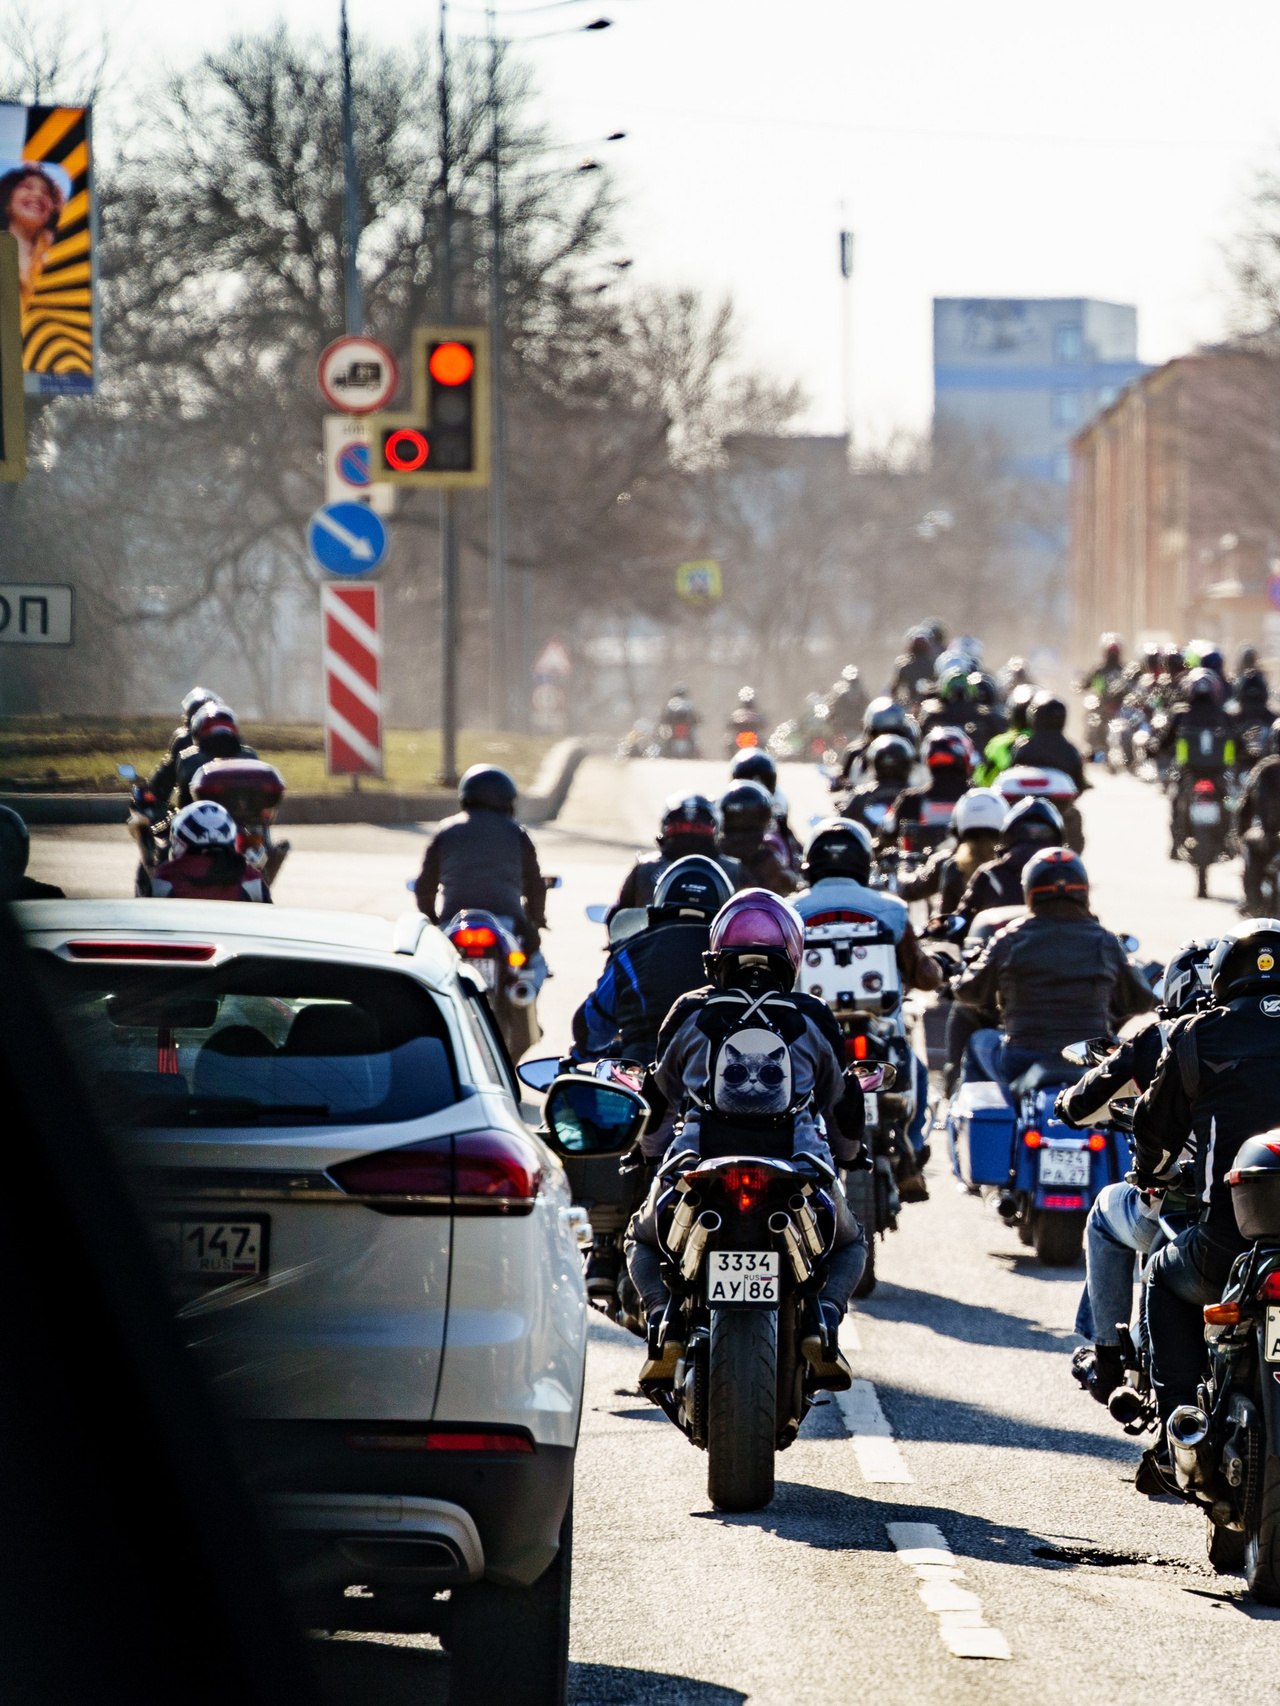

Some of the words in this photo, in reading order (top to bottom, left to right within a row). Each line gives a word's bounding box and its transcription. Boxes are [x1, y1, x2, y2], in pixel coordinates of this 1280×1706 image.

[186, 1226, 251, 1258] 147
[718, 1254, 770, 1271] 3334
[712, 1281, 742, 1299] АУ
[749, 1282, 774, 1299] 86
